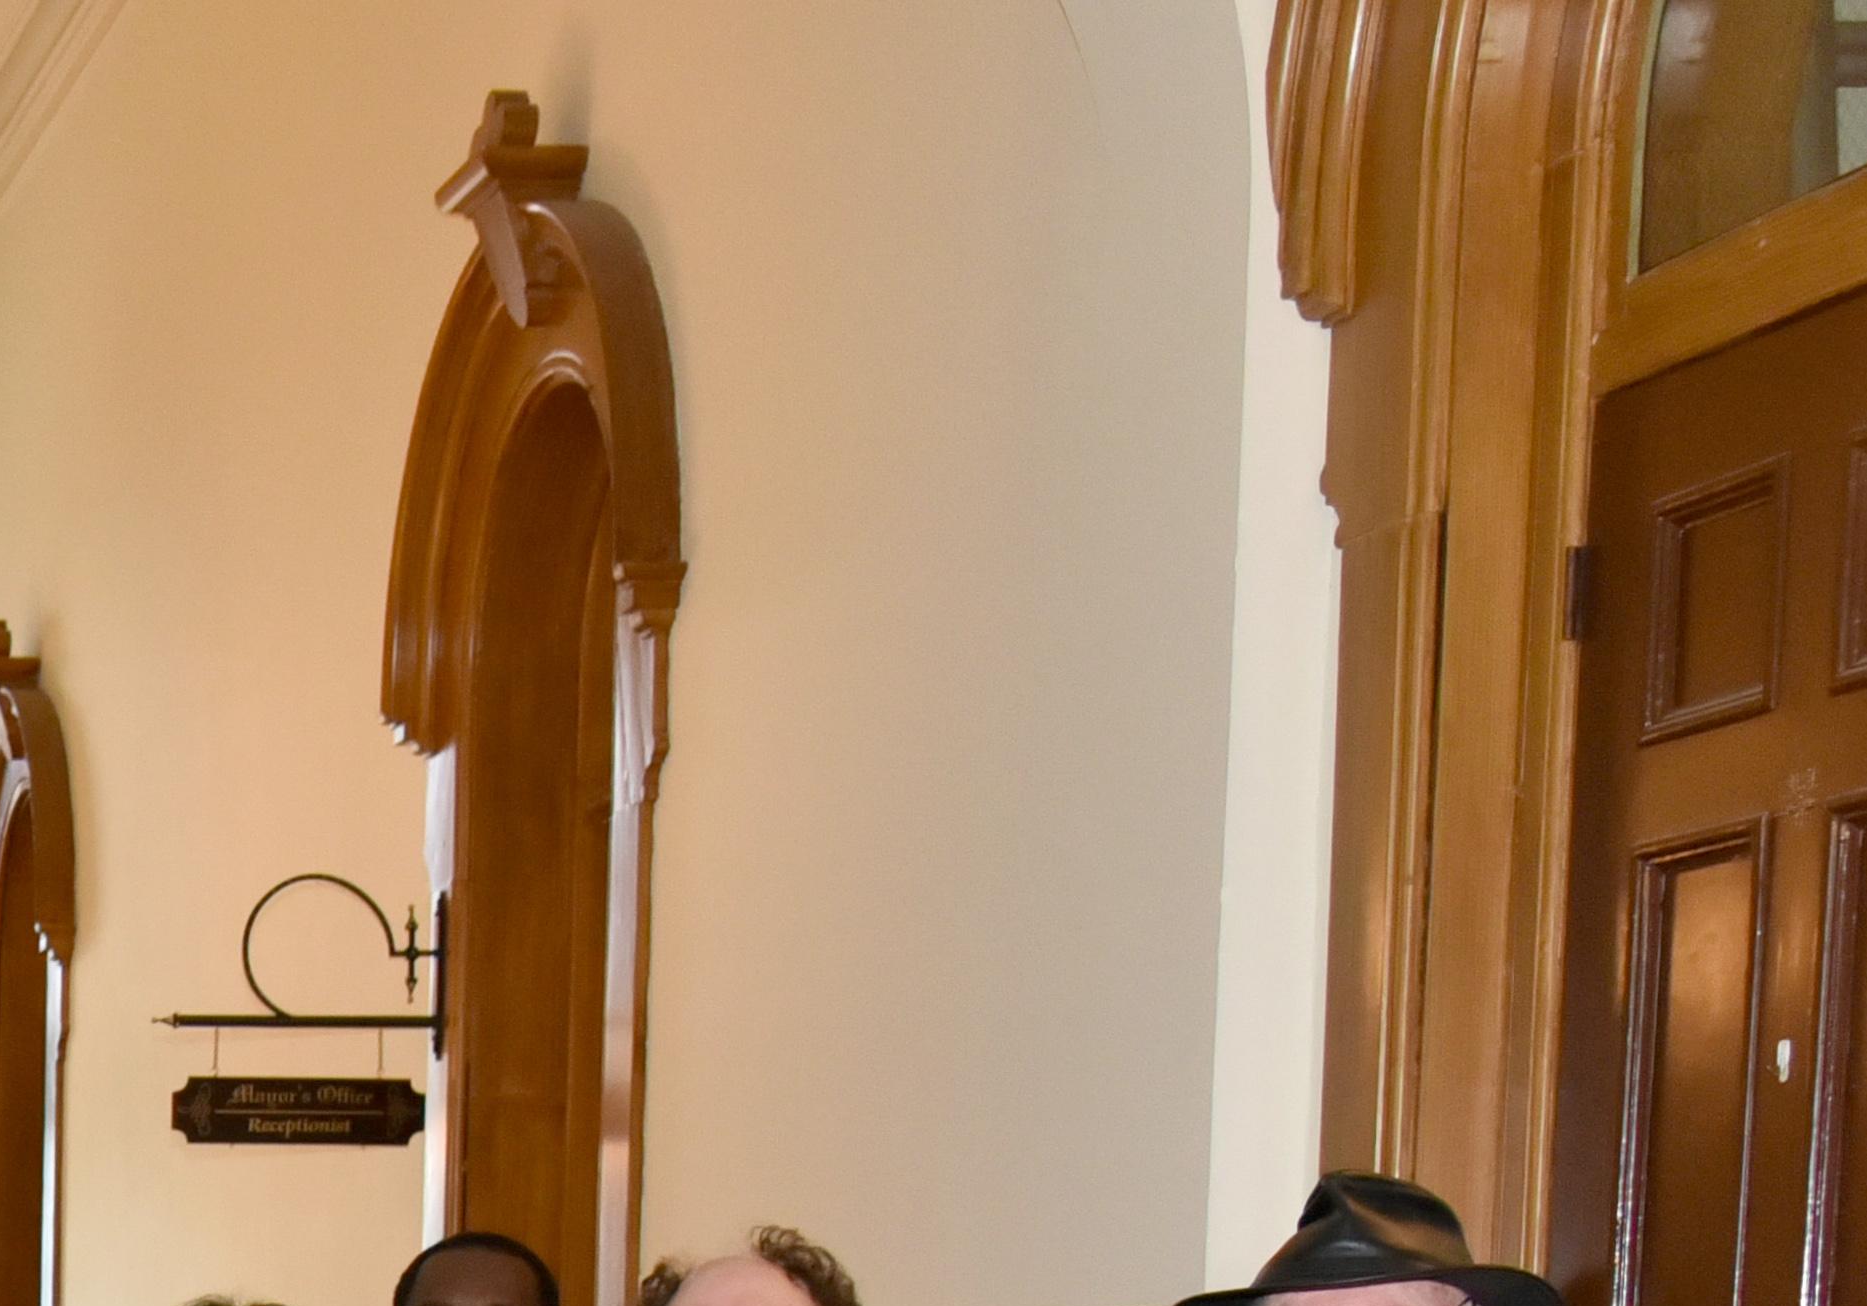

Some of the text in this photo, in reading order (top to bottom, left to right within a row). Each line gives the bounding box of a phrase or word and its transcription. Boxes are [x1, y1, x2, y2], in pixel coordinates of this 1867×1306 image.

[229, 1084, 374, 1108] Mayor's Office
[248, 1118, 351, 1138] Receptionist
